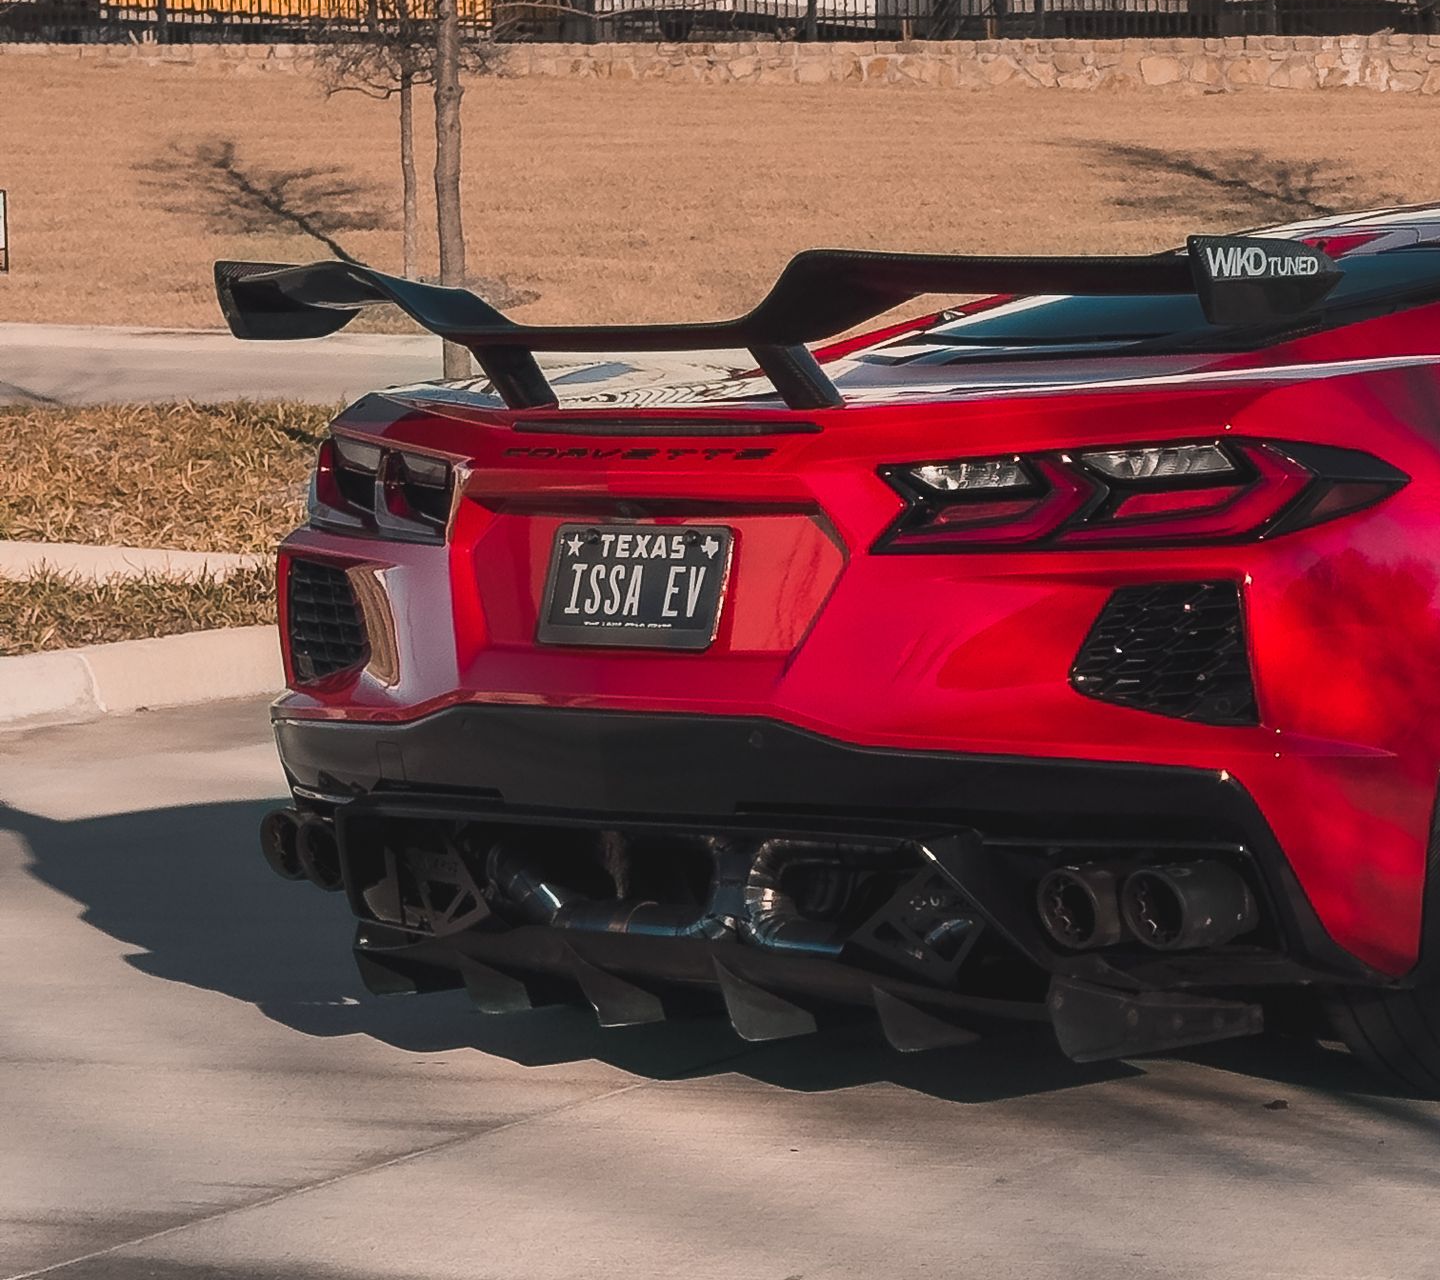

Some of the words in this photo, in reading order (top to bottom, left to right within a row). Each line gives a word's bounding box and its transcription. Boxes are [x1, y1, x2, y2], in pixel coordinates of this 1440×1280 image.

[1267, 256, 1319, 275] TUNED
[504, 447, 776, 461] CORVETTE
[601, 535, 686, 559] TEXAS
[564, 563, 643, 617] ISSA
[661, 566, 706, 618] EV
